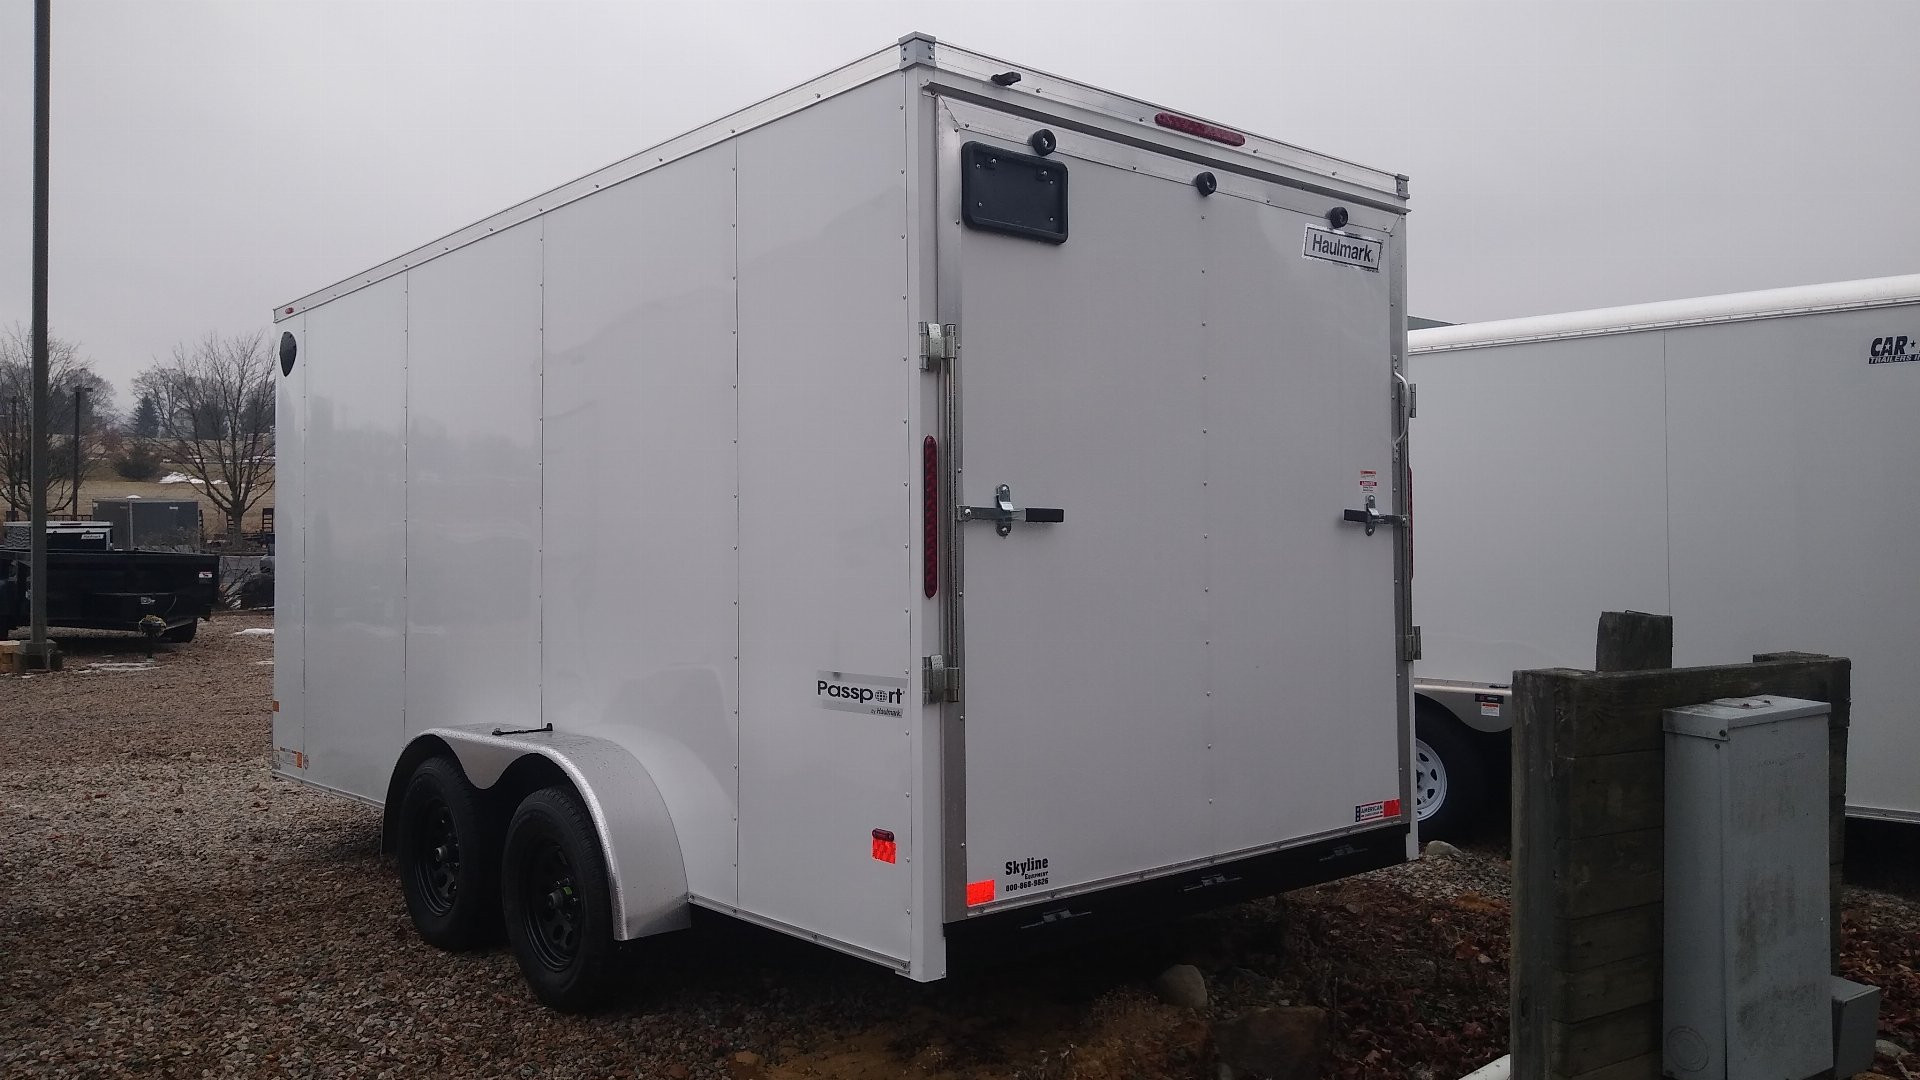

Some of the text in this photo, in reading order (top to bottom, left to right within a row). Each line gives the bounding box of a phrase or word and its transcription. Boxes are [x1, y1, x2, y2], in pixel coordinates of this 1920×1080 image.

[1871, 336, 1908, 356] CAR
[1869, 355, 1912, 364] TRAILERS
[1005, 857, 1049, 876] Skyline
